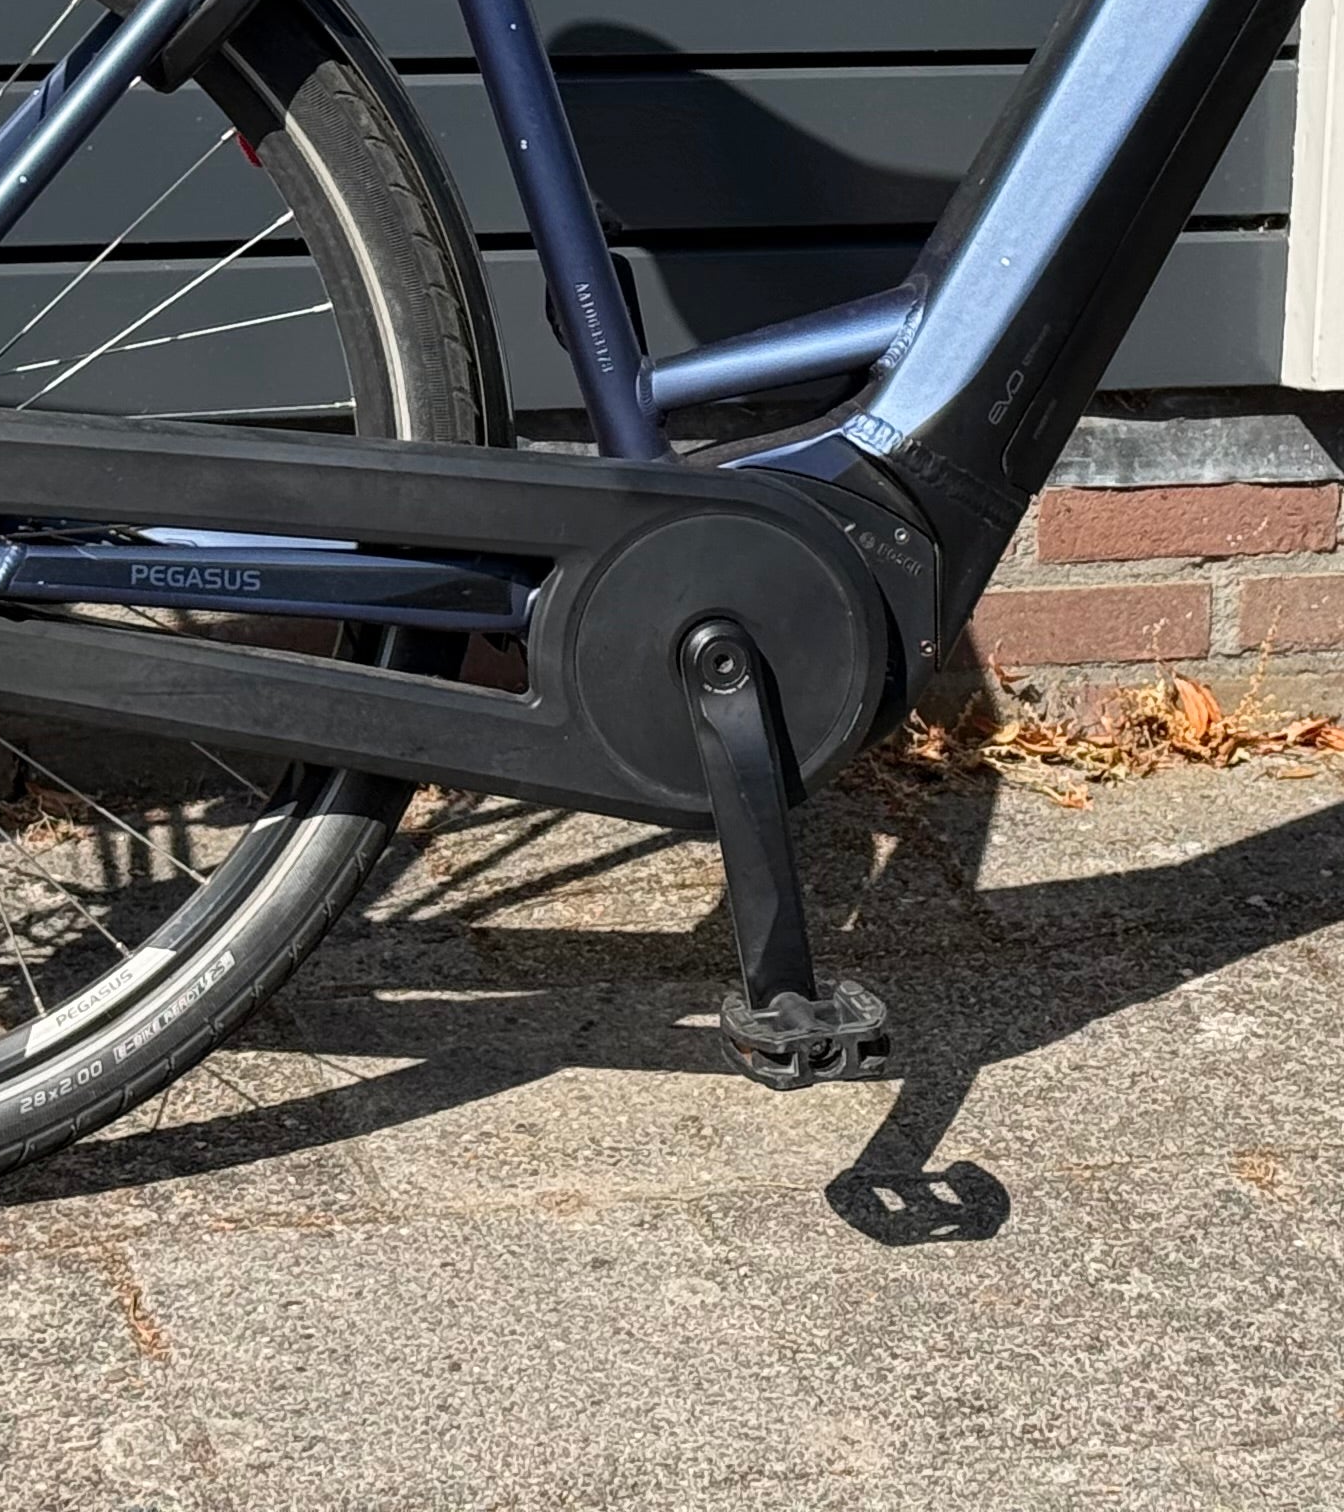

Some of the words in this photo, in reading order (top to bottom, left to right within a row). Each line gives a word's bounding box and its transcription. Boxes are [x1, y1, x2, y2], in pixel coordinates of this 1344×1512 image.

[988, 370, 1024, 425] EVO
[131, 564, 261, 591] PEGASUS
[56, 969, 133, 1027] PEGASUS
[19, 1060, 103, 1114] 28x2.00
